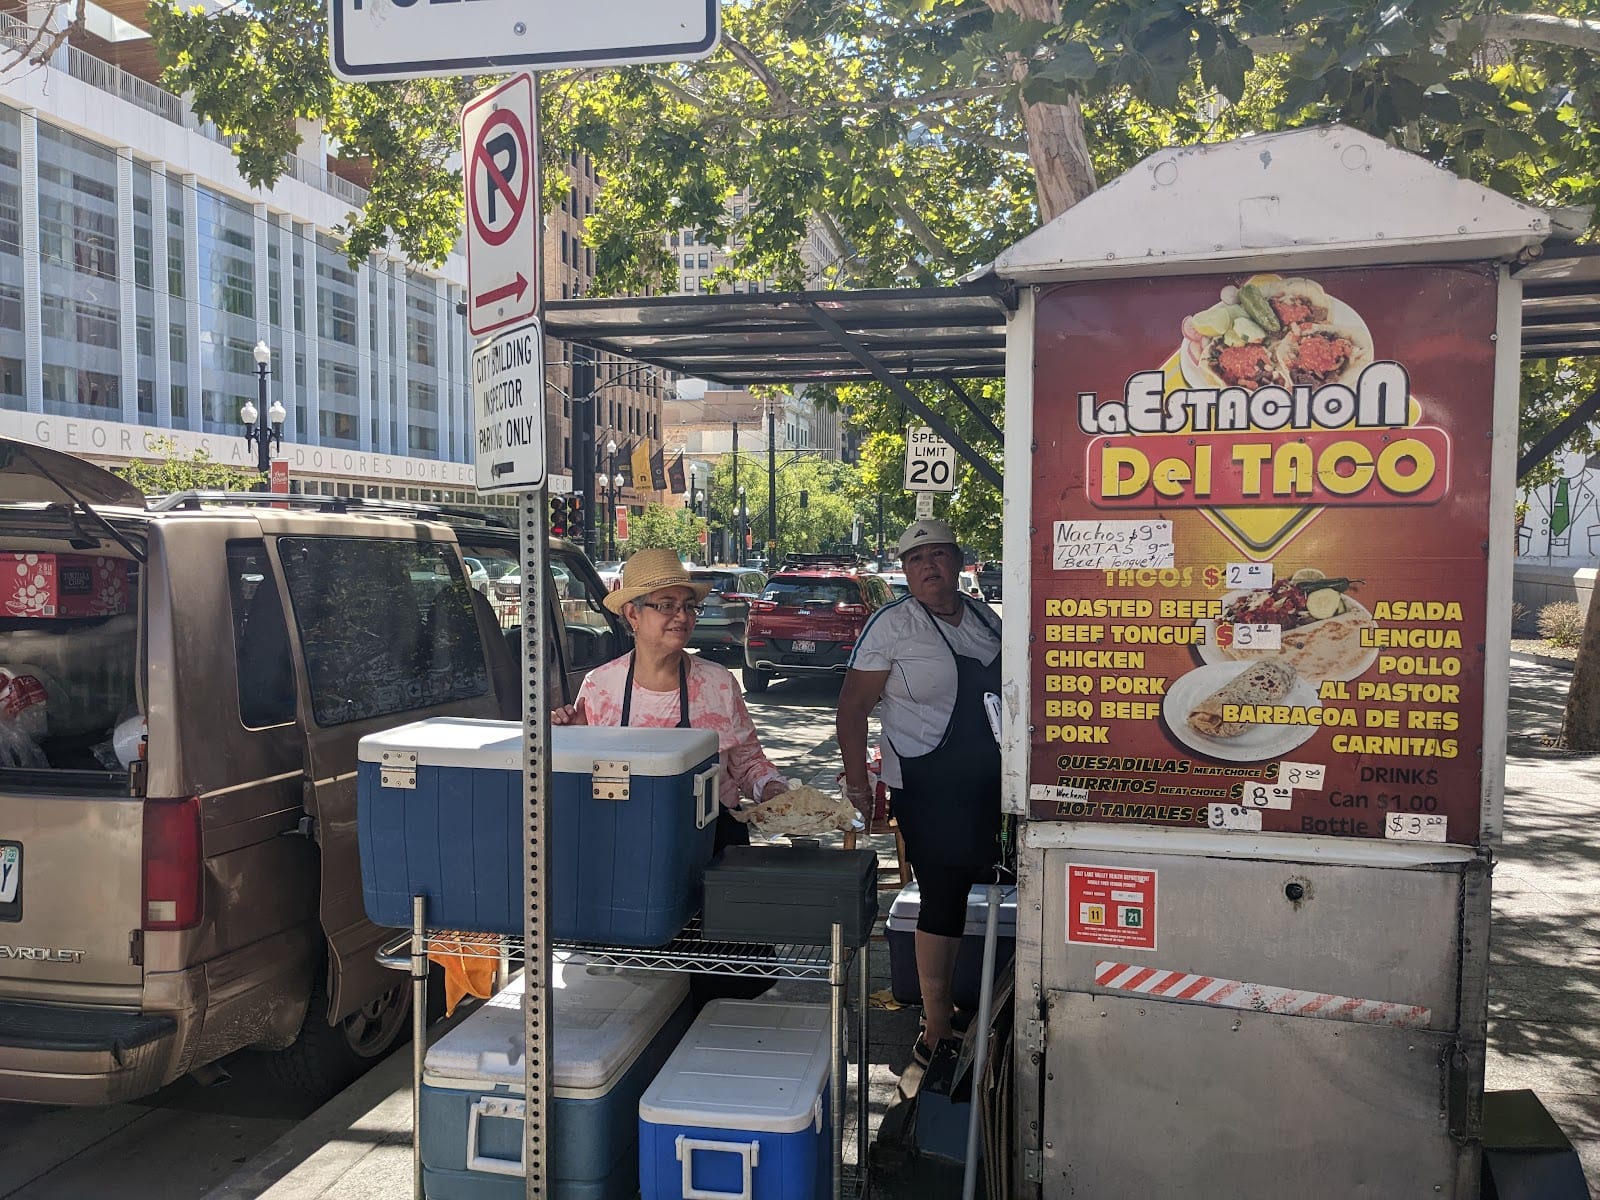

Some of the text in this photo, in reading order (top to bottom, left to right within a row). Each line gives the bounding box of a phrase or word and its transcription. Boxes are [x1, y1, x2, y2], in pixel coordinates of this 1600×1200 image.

[476, 354, 492, 384] CITY
[483, 378, 522, 417] INSPECTOR
[479, 416, 533, 454] PARKING ONLY
[911, 433, 947, 443] SPEE
[296, 448, 392, 474] DOLORES
[915, 446, 947, 457] LIMIT
[909, 460, 950, 484] 20
[1101, 438, 1436, 497] Del TACO
[1057, 522, 1125, 543] Nachos
[1058, 542, 1134, 560] TORTAS
[1062, 556, 1104, 568] Beef
[1103, 567, 1193, 588] TACOS
[1045, 599, 1222, 619] ROASTED BEEF
[1373, 601, 1463, 621] ASADA
[1045, 625, 1104, 642] BEEF
[1111, 626, 1206, 645] TONGUE
[1360, 628, 1462, 648] LENGUA
[1045, 650, 1145, 669] CHICKEN
[1379, 656, 1461, 676] POLLO
[1045, 675, 1167, 695] BBQ PORK
[1319, 681, 1460, 703] AL PASTOR
[1045, 700, 1161, 721] BBQ BEEF
[1222, 704, 1459, 731] BARBACOA DE RES
[1045, 725, 1110, 743] PORK
[1332, 734, 1459, 758] CARNITAS
[1057, 756, 1190, 773] QUESADILLAS
[1193, 767, 1222, 776] MEAT
[1224, 769, 1261, 777] CHOICE
[1360, 767, 1438, 784] DRINKS
[1057, 777, 1156, 793] BURRITOS
[1160, 786, 1188, 795] MEAT
[1188, 788, 1225, 797] CHOICE
[1057, 802, 1097, 816] HOT
[1101, 803, 1192, 821] TAMALES
[1329, 792, 1438, 812] Can $1.00
[1301, 816, 1368, 834] Bottle
[1092, 911, 1099, 920] 11
[1128, 913, 1138, 923] 21
[0, 946, 86, 964] EVROLET
